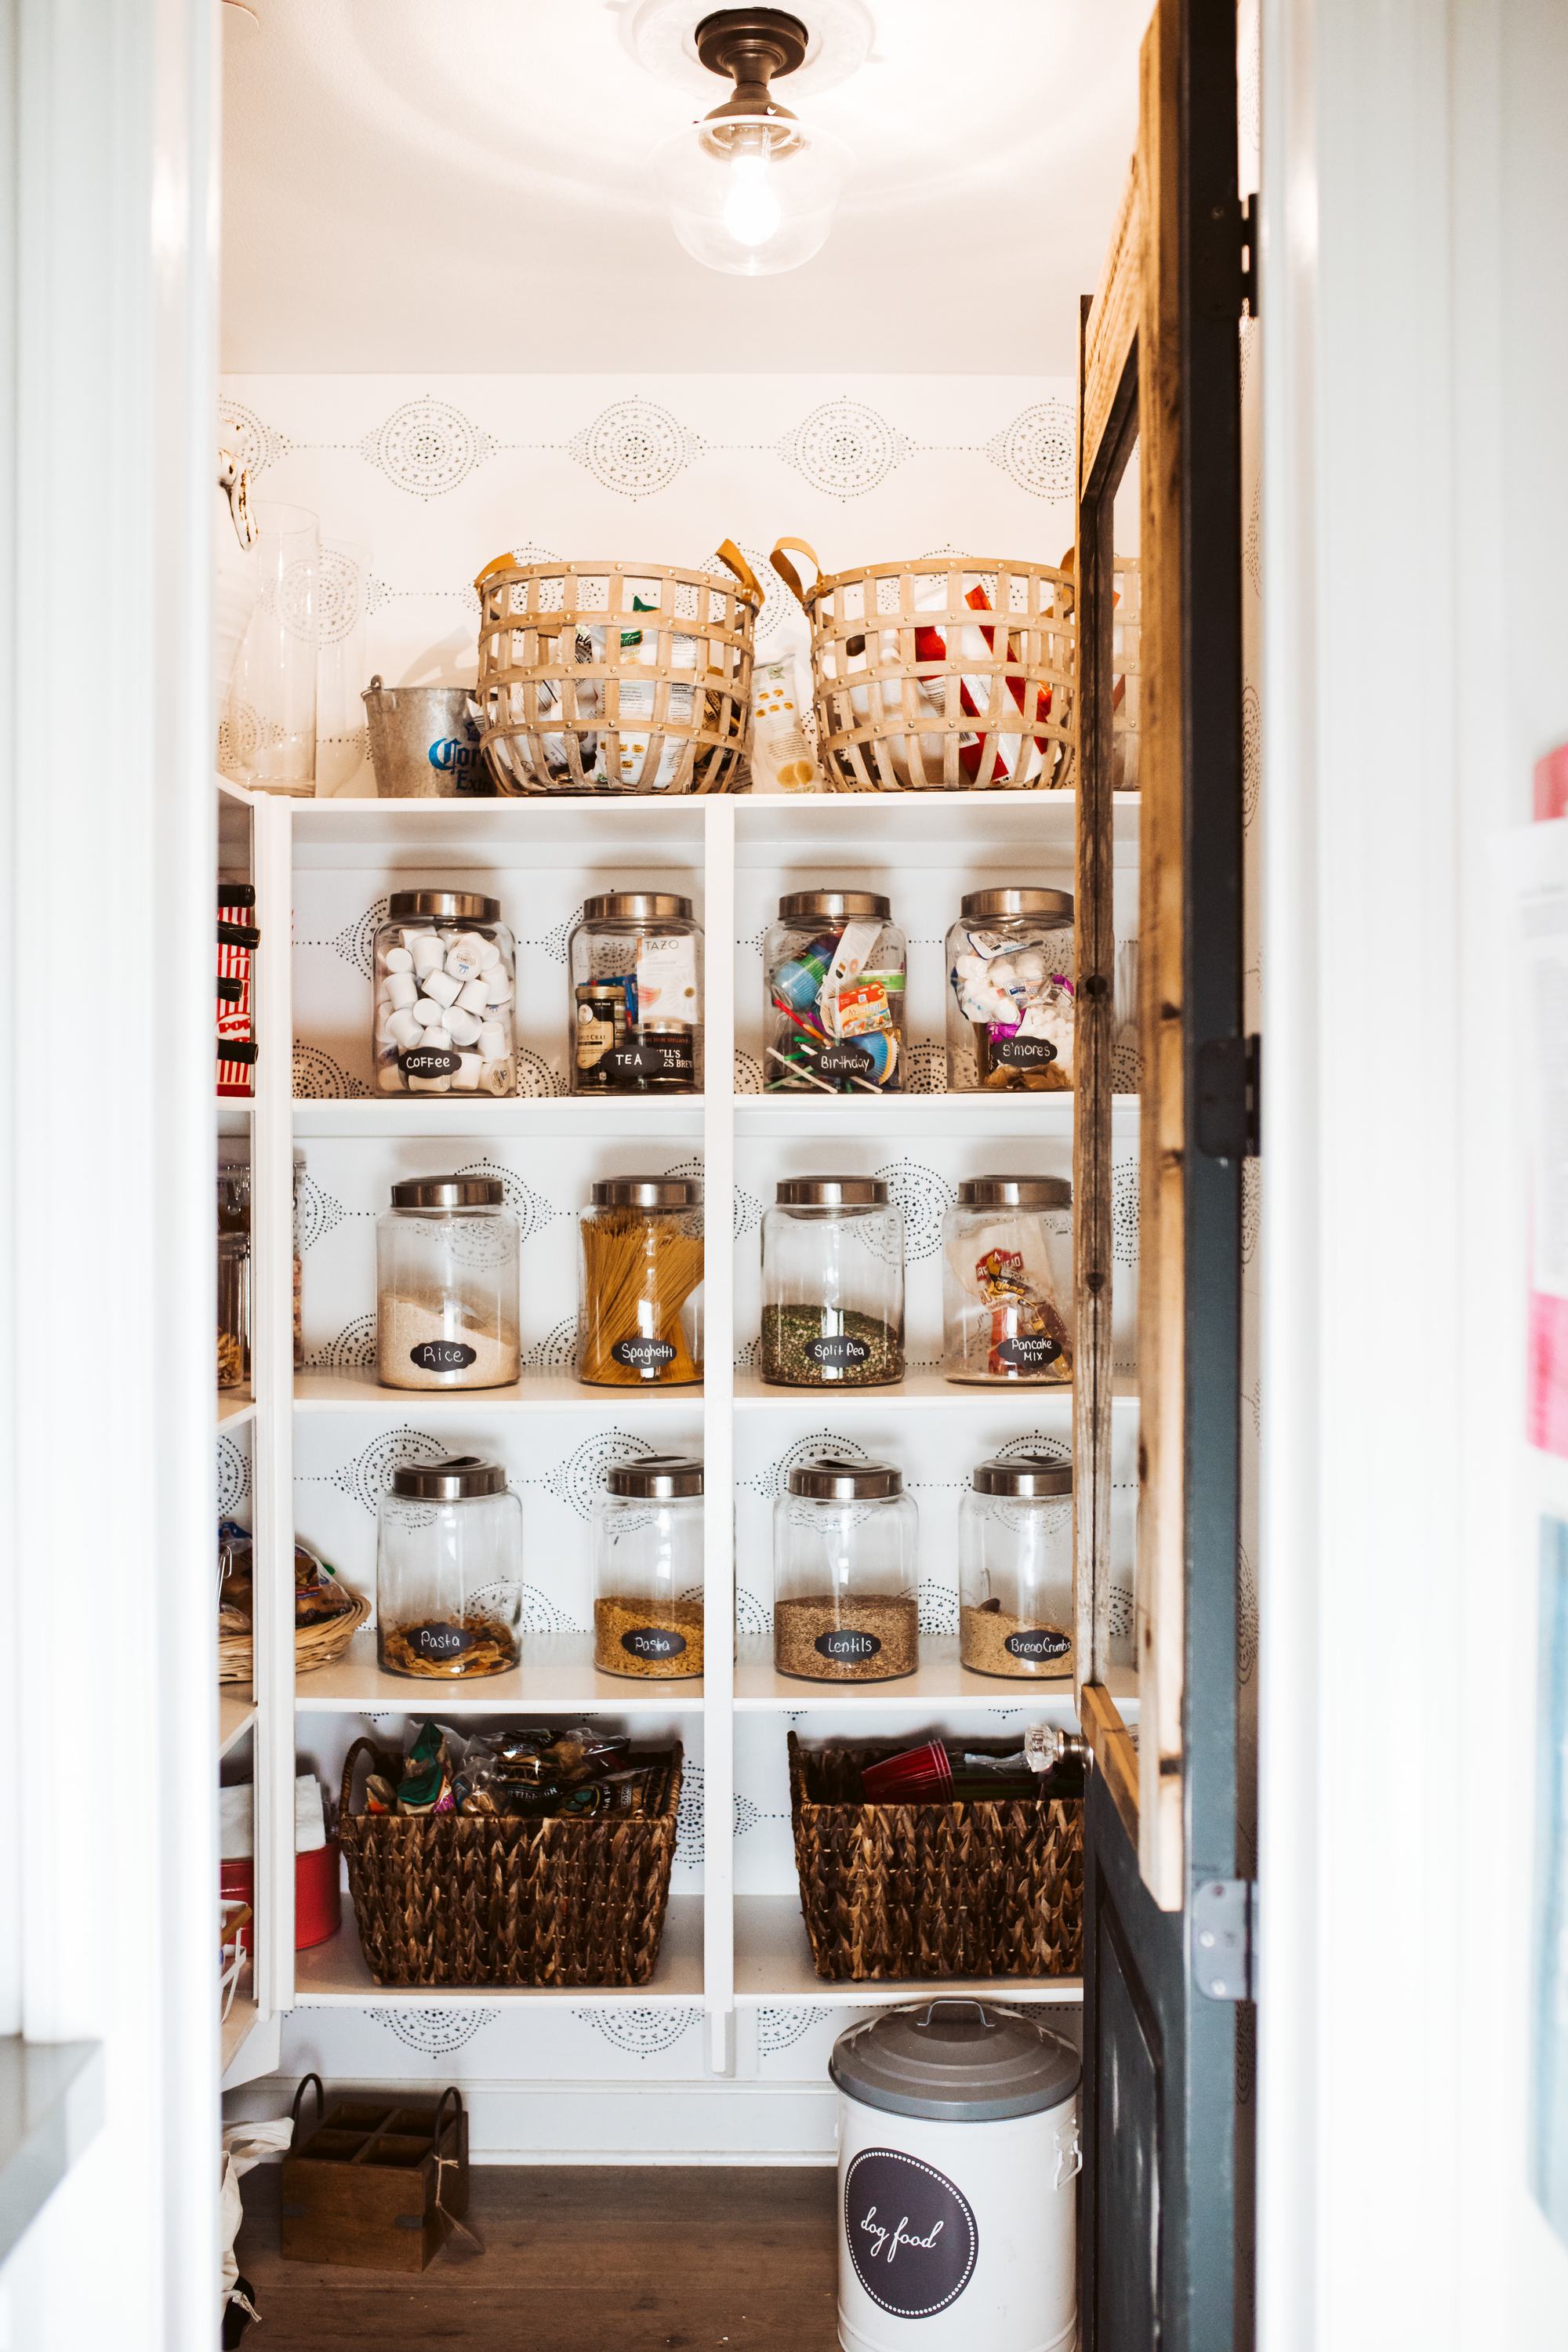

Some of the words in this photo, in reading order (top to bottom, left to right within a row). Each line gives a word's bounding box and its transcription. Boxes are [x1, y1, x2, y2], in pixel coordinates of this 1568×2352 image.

[645, 940, 679, 950] TAZO
[1003, 1042, 1051, 1057] S'mores
[615, 1053, 643, 1065] TEA
[821, 1054, 869, 1073] Birthday
[815, 1345, 844, 1360] Split
[847, 1342, 865, 1356] Pea
[1011, 1338, 1052, 1351] Pancake
[423, 1346, 463, 1363] Rice
[622, 1343, 673, 1365] Spaghetti
[421, 1631, 460, 1649] Pasta
[634, 1636, 670, 1652] Pasta
[828, 1637, 872, 1653] Lentils
[861, 2206, 890, 2257] dog
[887, 2216, 944, 2263] food
